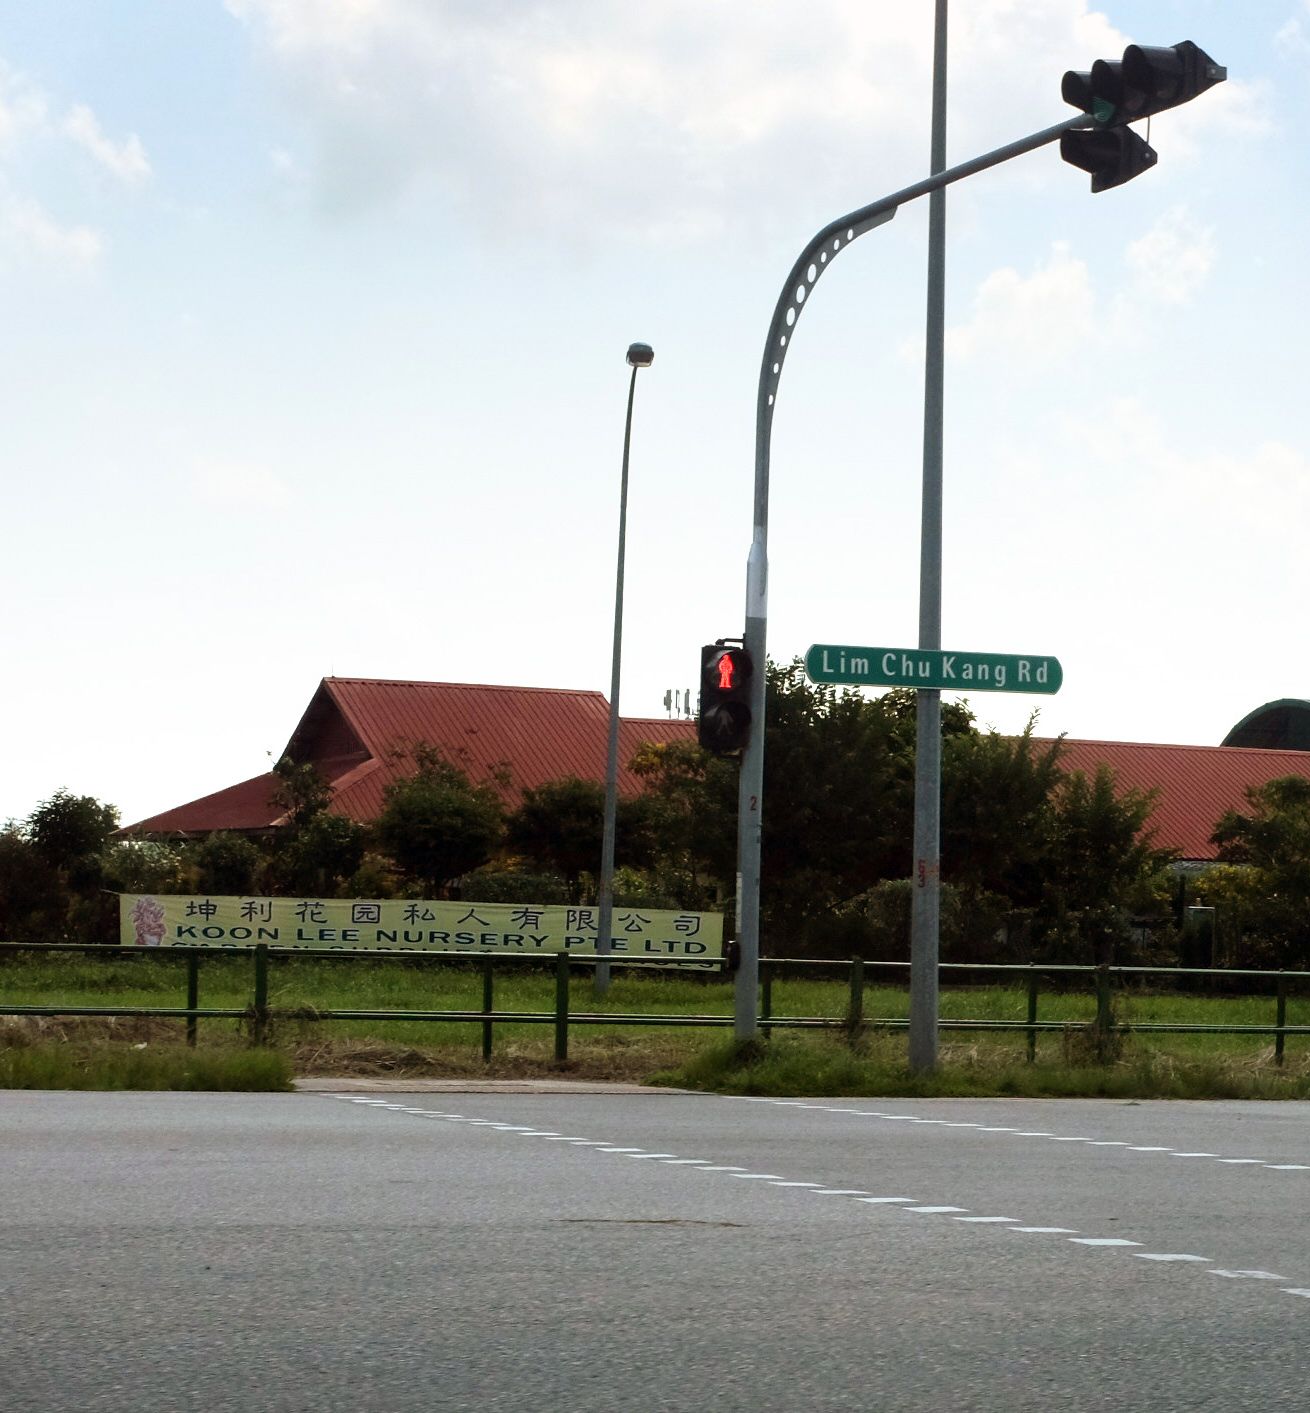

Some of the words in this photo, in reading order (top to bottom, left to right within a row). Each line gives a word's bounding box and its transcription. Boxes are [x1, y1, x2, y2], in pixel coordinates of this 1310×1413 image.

[821, 651, 869, 675] Lim
[881, 653, 930, 677] Chu
[942, 656, 1007, 687] Kang
[1017, 661, 1048, 683] Rd
[186, 899, 700, 937] 坤利花园私人有限公司
[176, 926, 279, 940] KOON
[297, 928, 359, 941] LEE
[376, 930, 549, 947] NURSERY
[645, 940, 707, 955] LTD
